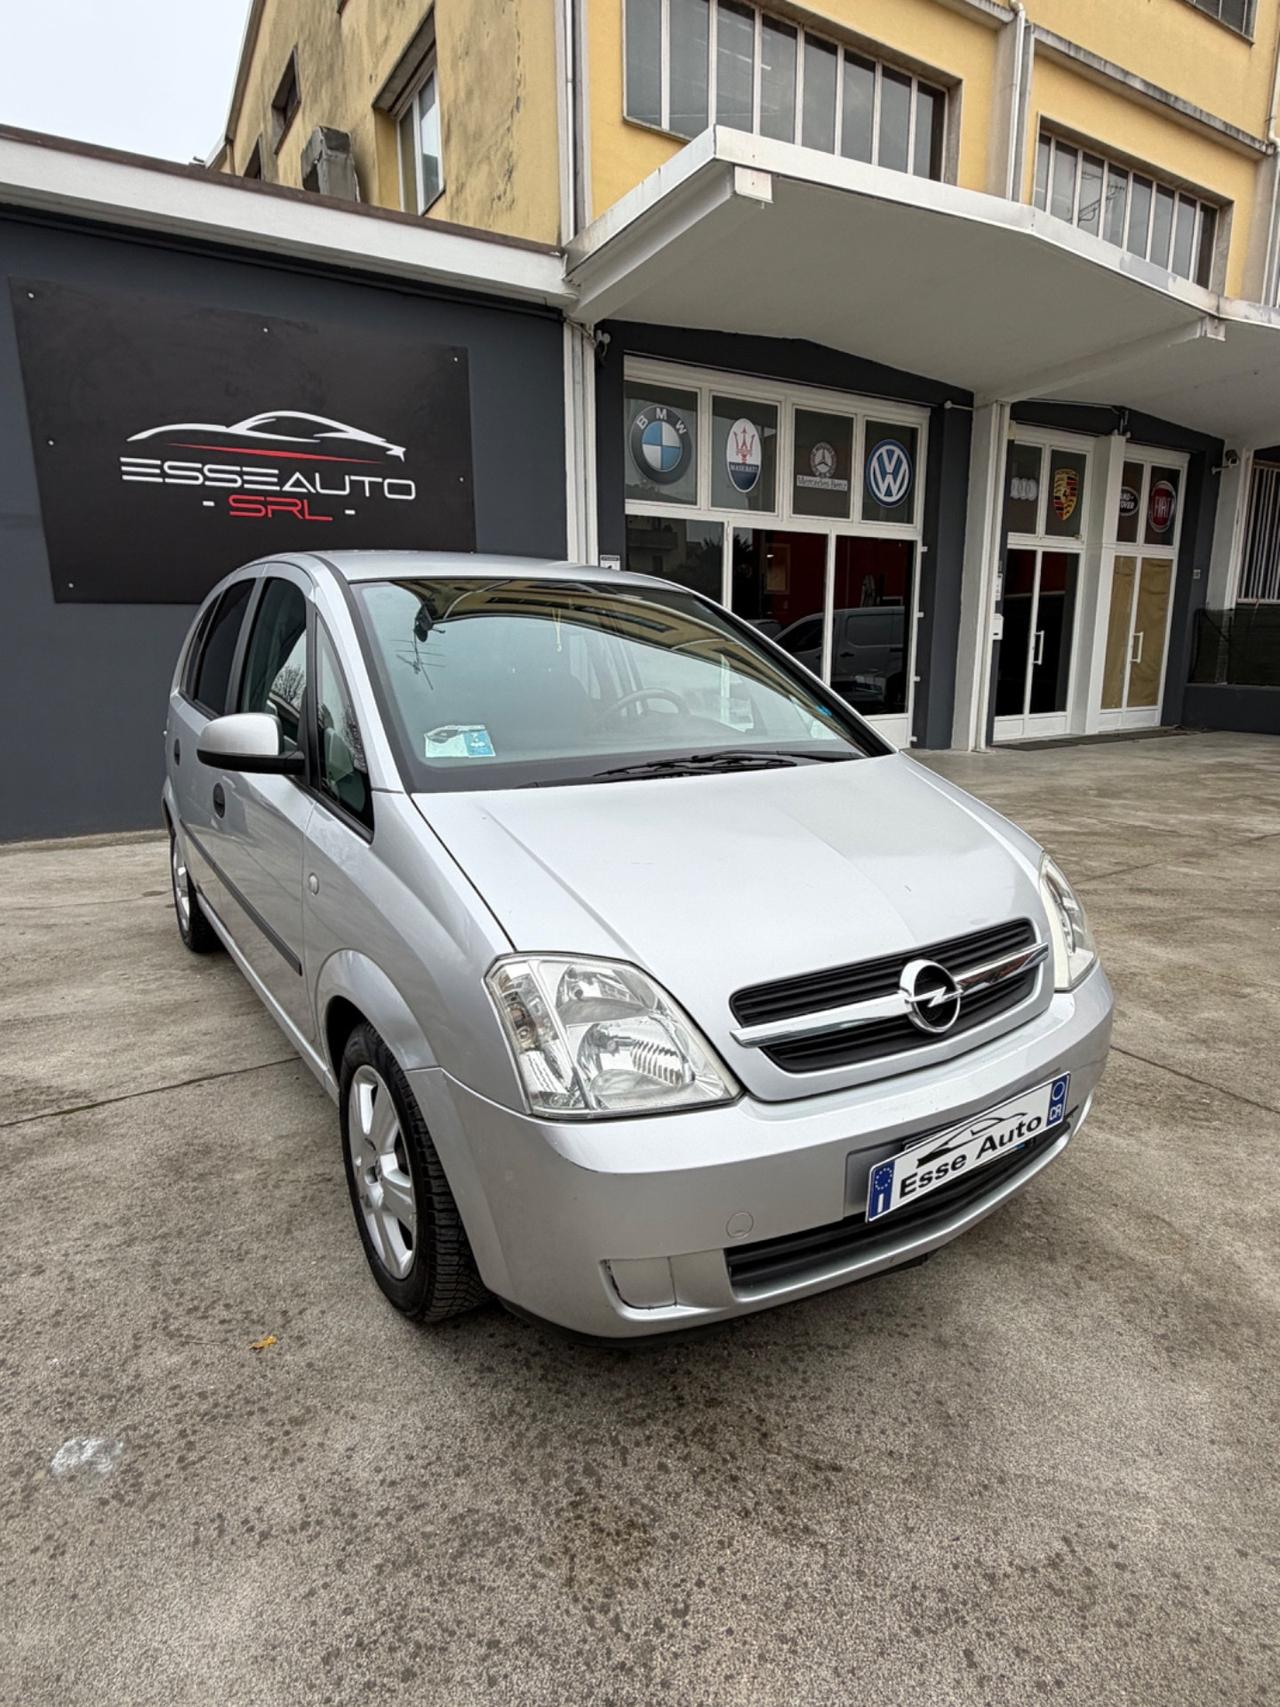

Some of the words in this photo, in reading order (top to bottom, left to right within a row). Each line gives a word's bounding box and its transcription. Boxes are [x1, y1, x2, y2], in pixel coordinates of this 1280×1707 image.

[636, 407, 688, 435] BMW
[119, 456, 416, 500] ESSEAUTO
[228, 494, 333, 521] SRL
[1049, 1103, 1062, 1121] CR
[899, 1153, 967, 1199] Esse
[975, 1115, 1042, 1159] Auto
[877, 1193, 884, 1213] I
